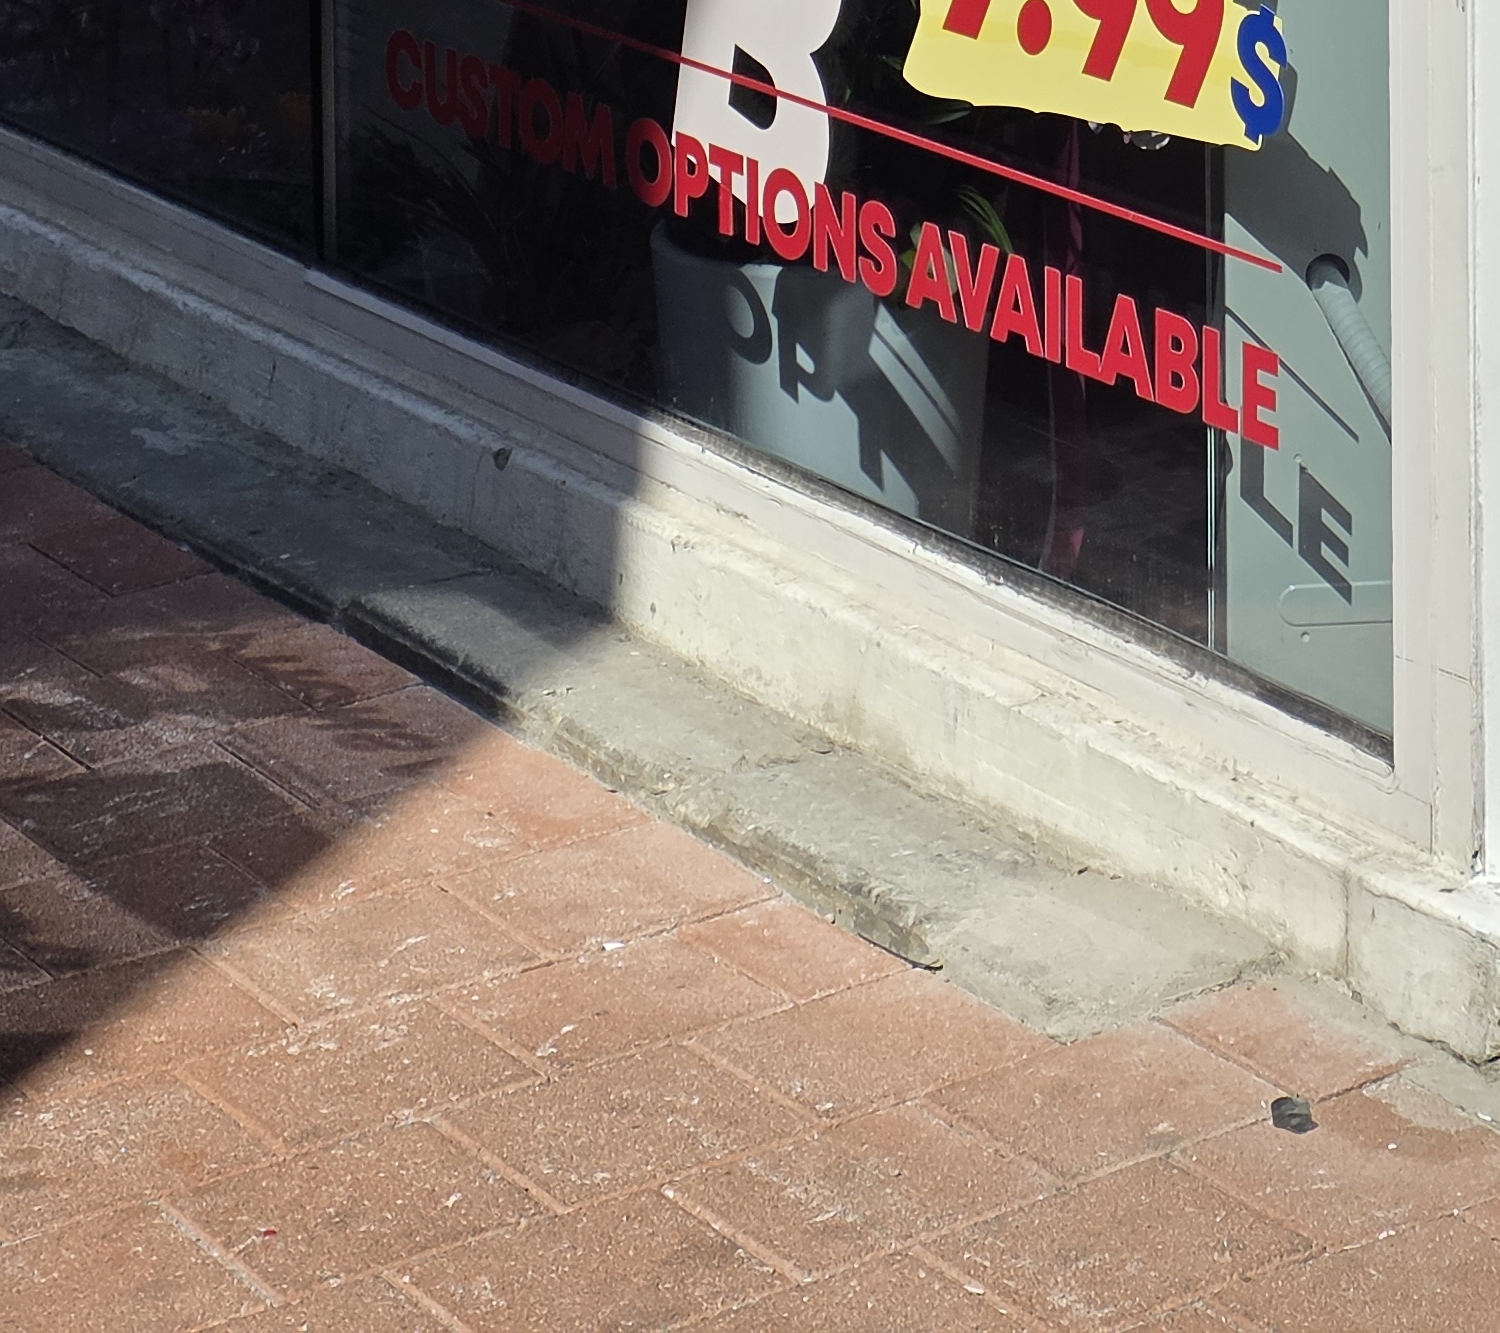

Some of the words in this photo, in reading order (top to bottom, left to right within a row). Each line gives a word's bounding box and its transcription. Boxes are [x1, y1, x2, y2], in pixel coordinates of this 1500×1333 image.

[386, 29, 617, 190] CUSTOM
[626, 117, 899, 298] OPTIONS
[906, 220, 1280, 451] AVAILABLE
